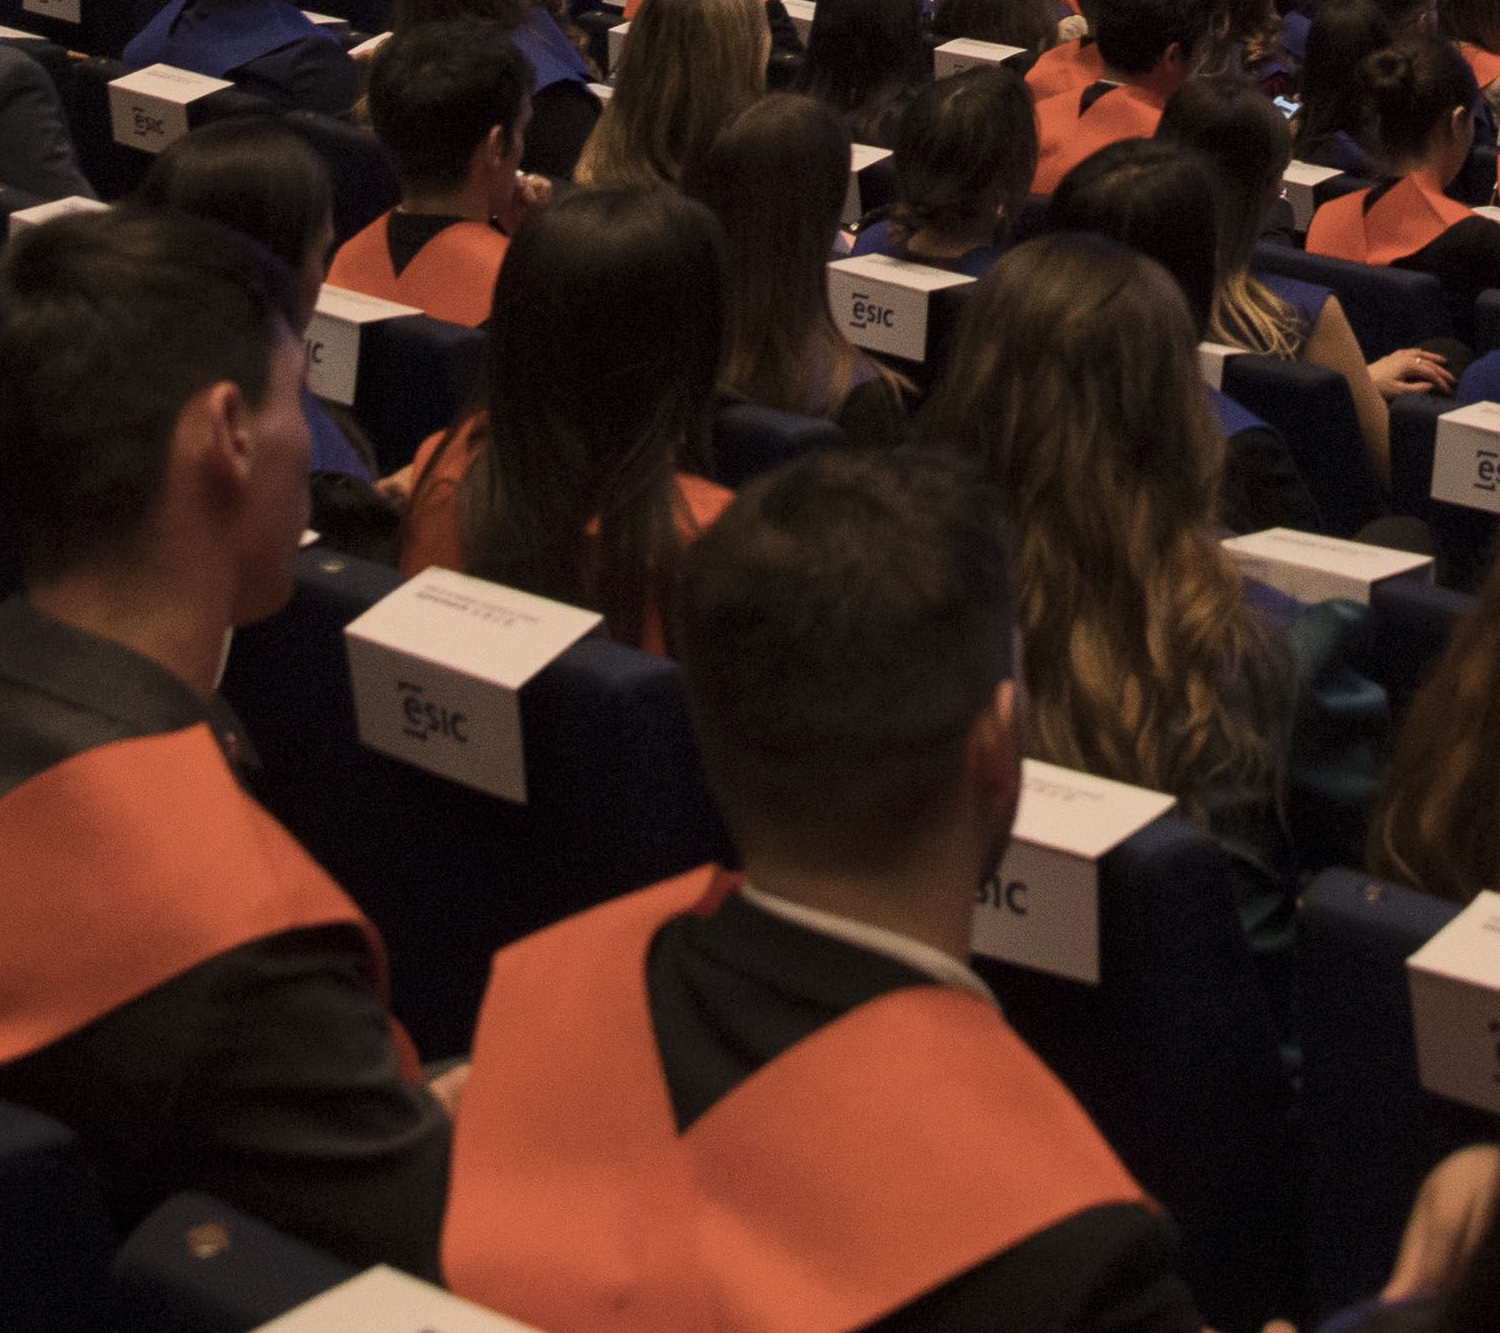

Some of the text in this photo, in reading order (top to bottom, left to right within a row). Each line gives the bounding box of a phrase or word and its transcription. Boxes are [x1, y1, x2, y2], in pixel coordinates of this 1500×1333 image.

[853, 300, 895, 328] esic
[403, 695, 468, 745] esic
[975, 875, 1029, 917] sic
